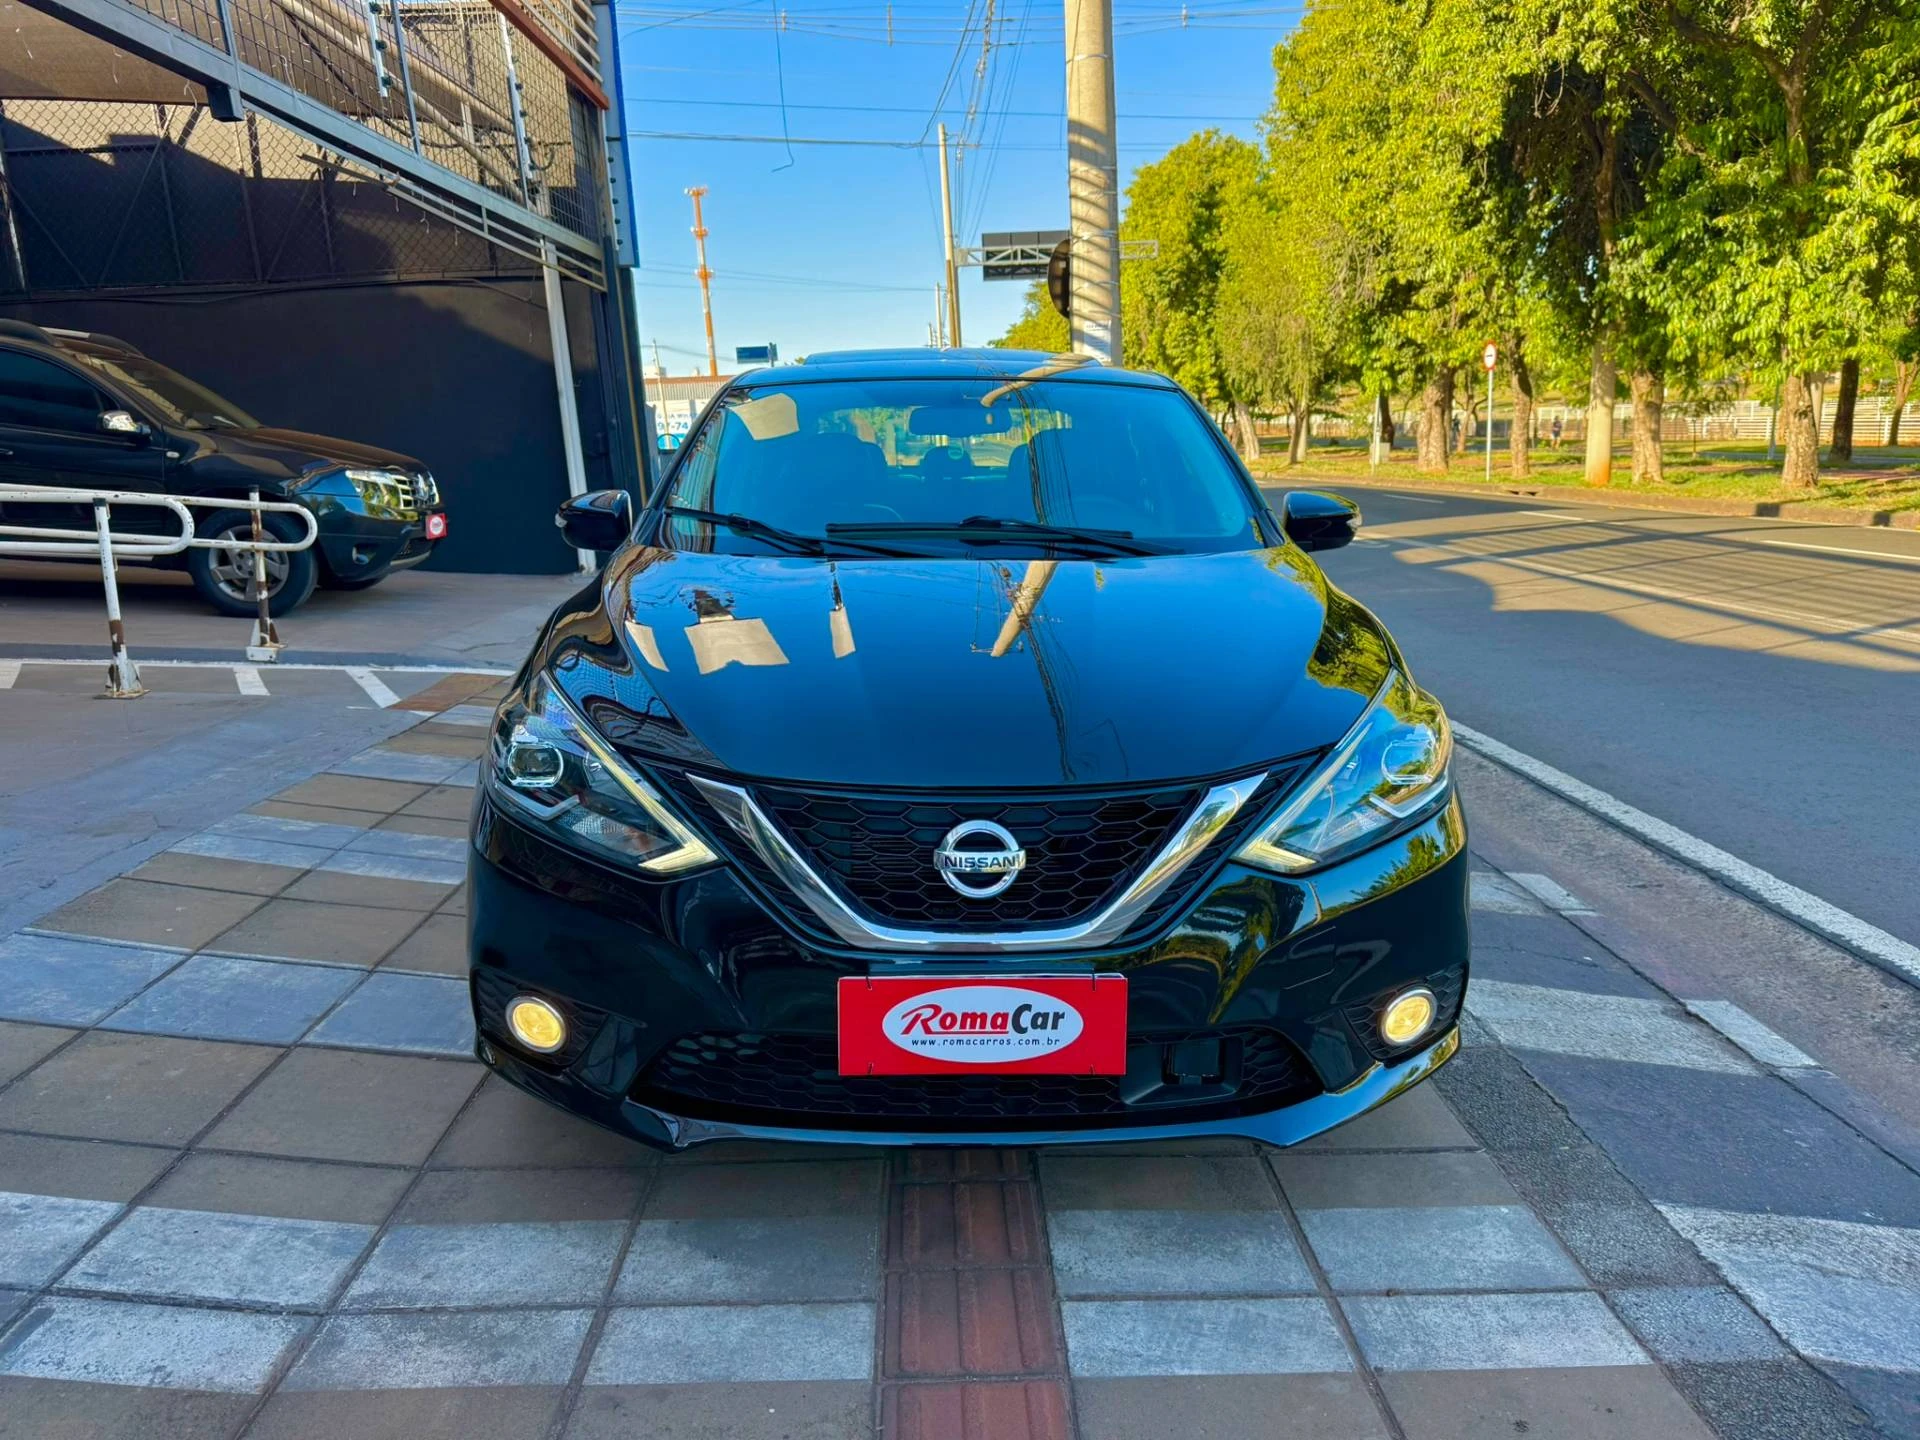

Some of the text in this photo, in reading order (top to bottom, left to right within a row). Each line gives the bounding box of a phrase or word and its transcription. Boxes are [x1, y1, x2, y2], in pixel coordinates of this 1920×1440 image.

[944, 855, 1016, 868] NISSAN
[901, 1003, 1065, 1035] RomaCar
[911, 1037, 1060, 1046] www.romacarros.com.br
